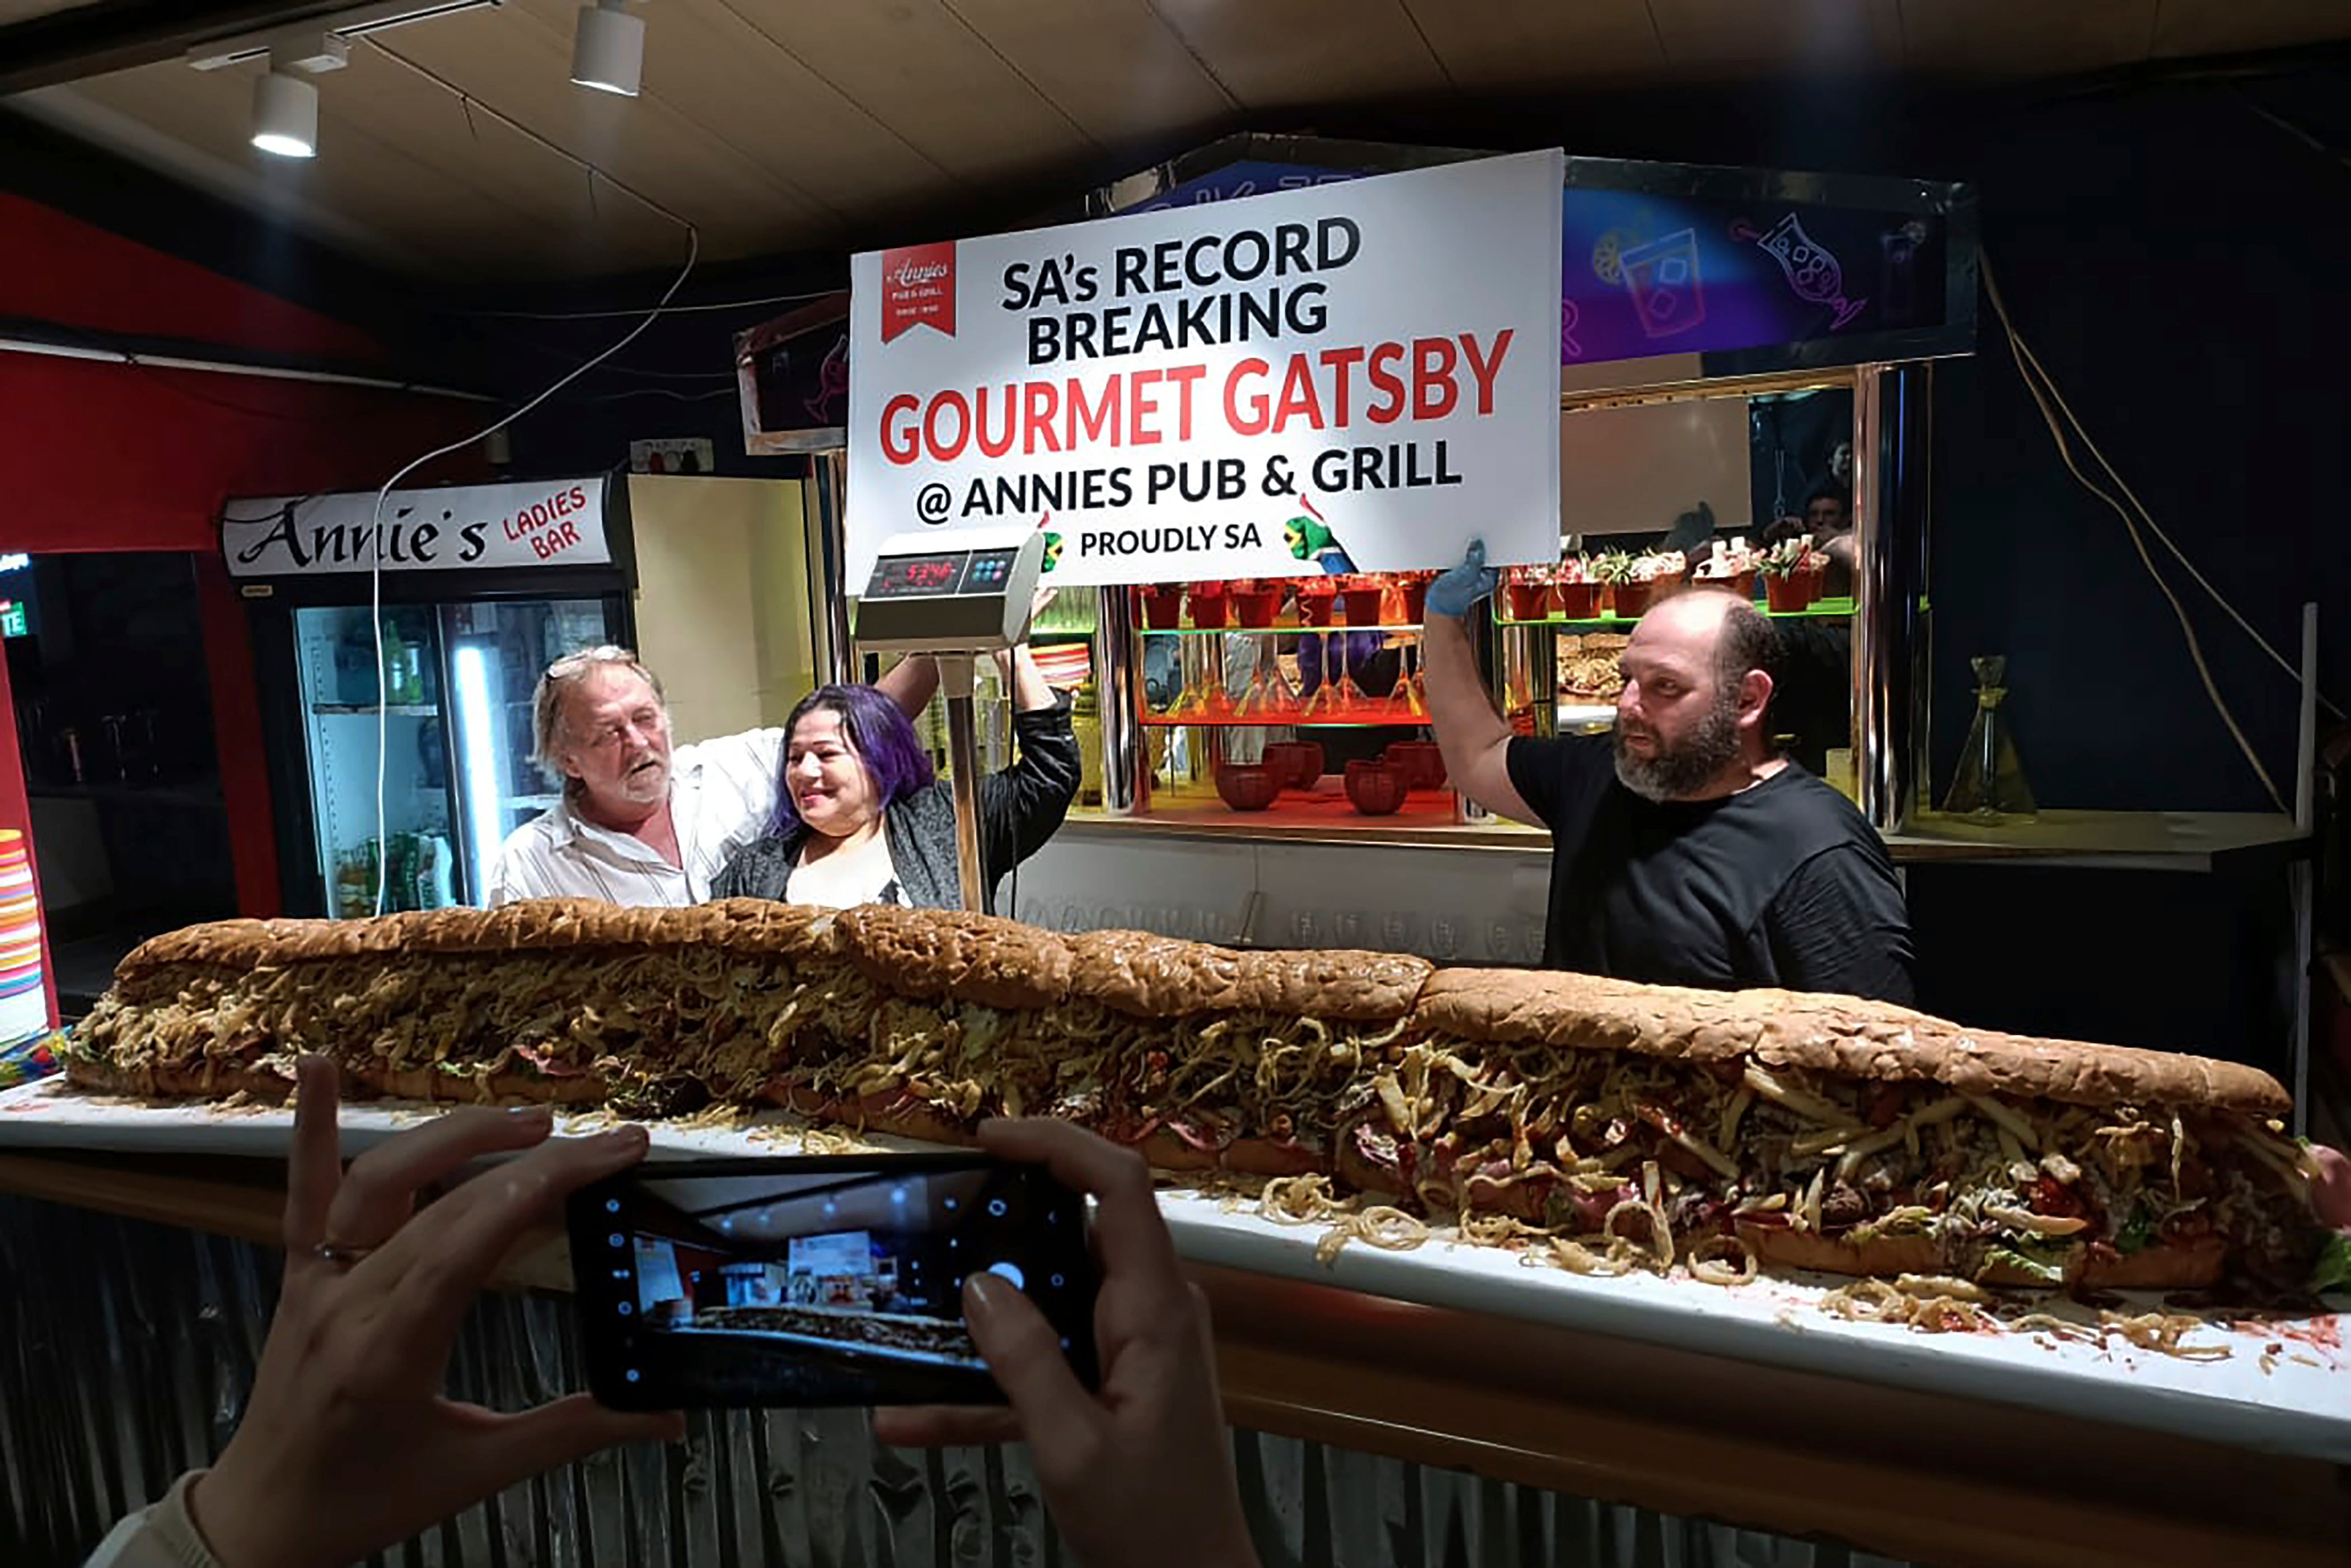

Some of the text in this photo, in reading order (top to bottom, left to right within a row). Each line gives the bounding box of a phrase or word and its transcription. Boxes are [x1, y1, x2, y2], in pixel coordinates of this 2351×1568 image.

[1116, 217, 1360, 297] RECORD
[1028, 282, 1327, 365] BREAKING
[881, 329, 1514, 465] GOURMET GATSBY
[502, 486, 587, 541] LADIES
[917, 440, 1463, 525] @ ANNIES PUB & GRILL
[237, 495, 488, 567] Annie's
[531, 521, 580, 560] BAR
[1081, 523, 1262, 558] PROUDLY SA
